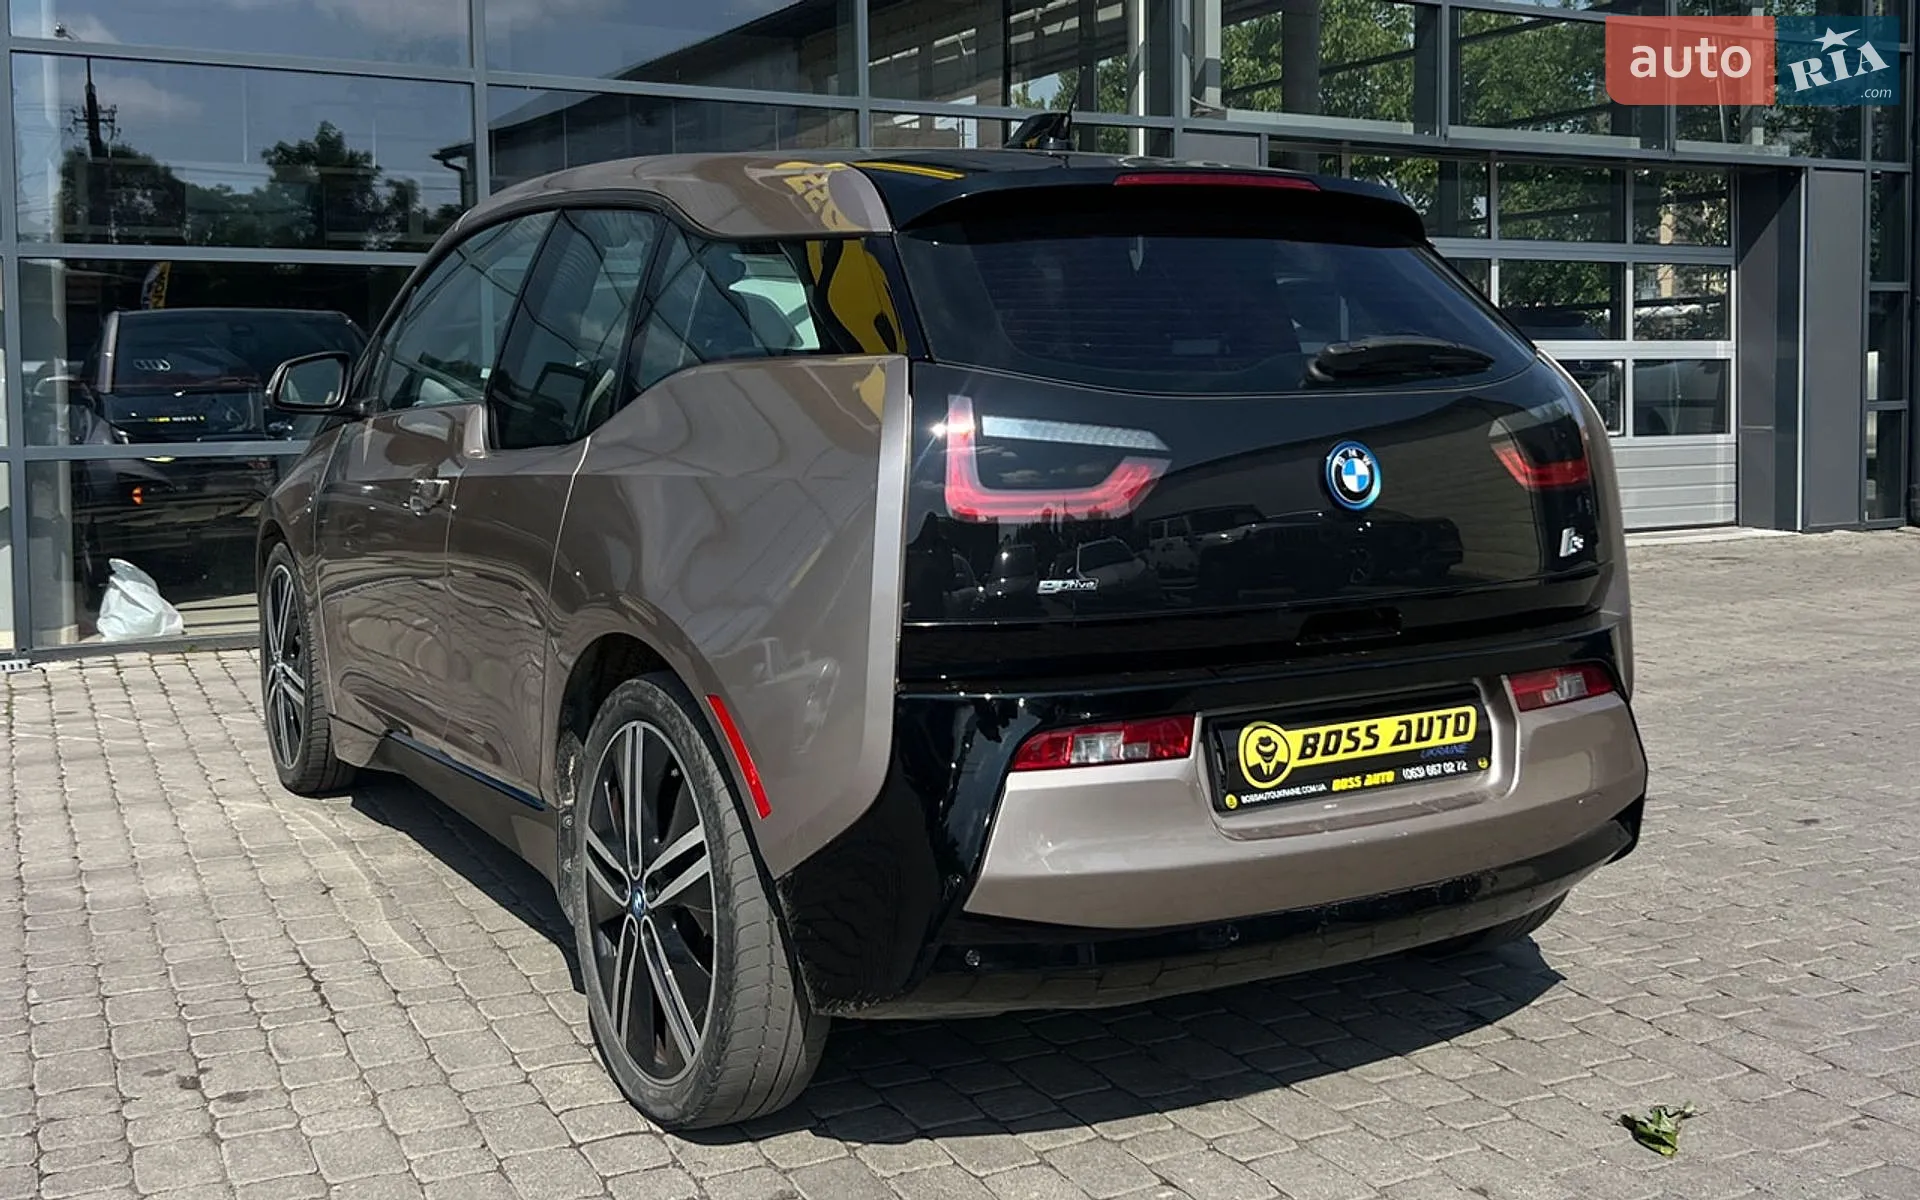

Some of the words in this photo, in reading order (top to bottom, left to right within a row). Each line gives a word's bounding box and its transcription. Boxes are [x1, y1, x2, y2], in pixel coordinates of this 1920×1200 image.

[1336, 448, 1371, 467] BMW
[1297, 724, 1380, 761] BOSS
[1390, 710, 1471, 747] AUTO
[1332, 776, 1361, 791] BOSS
[1364, 771, 1395, 786] AUTO
